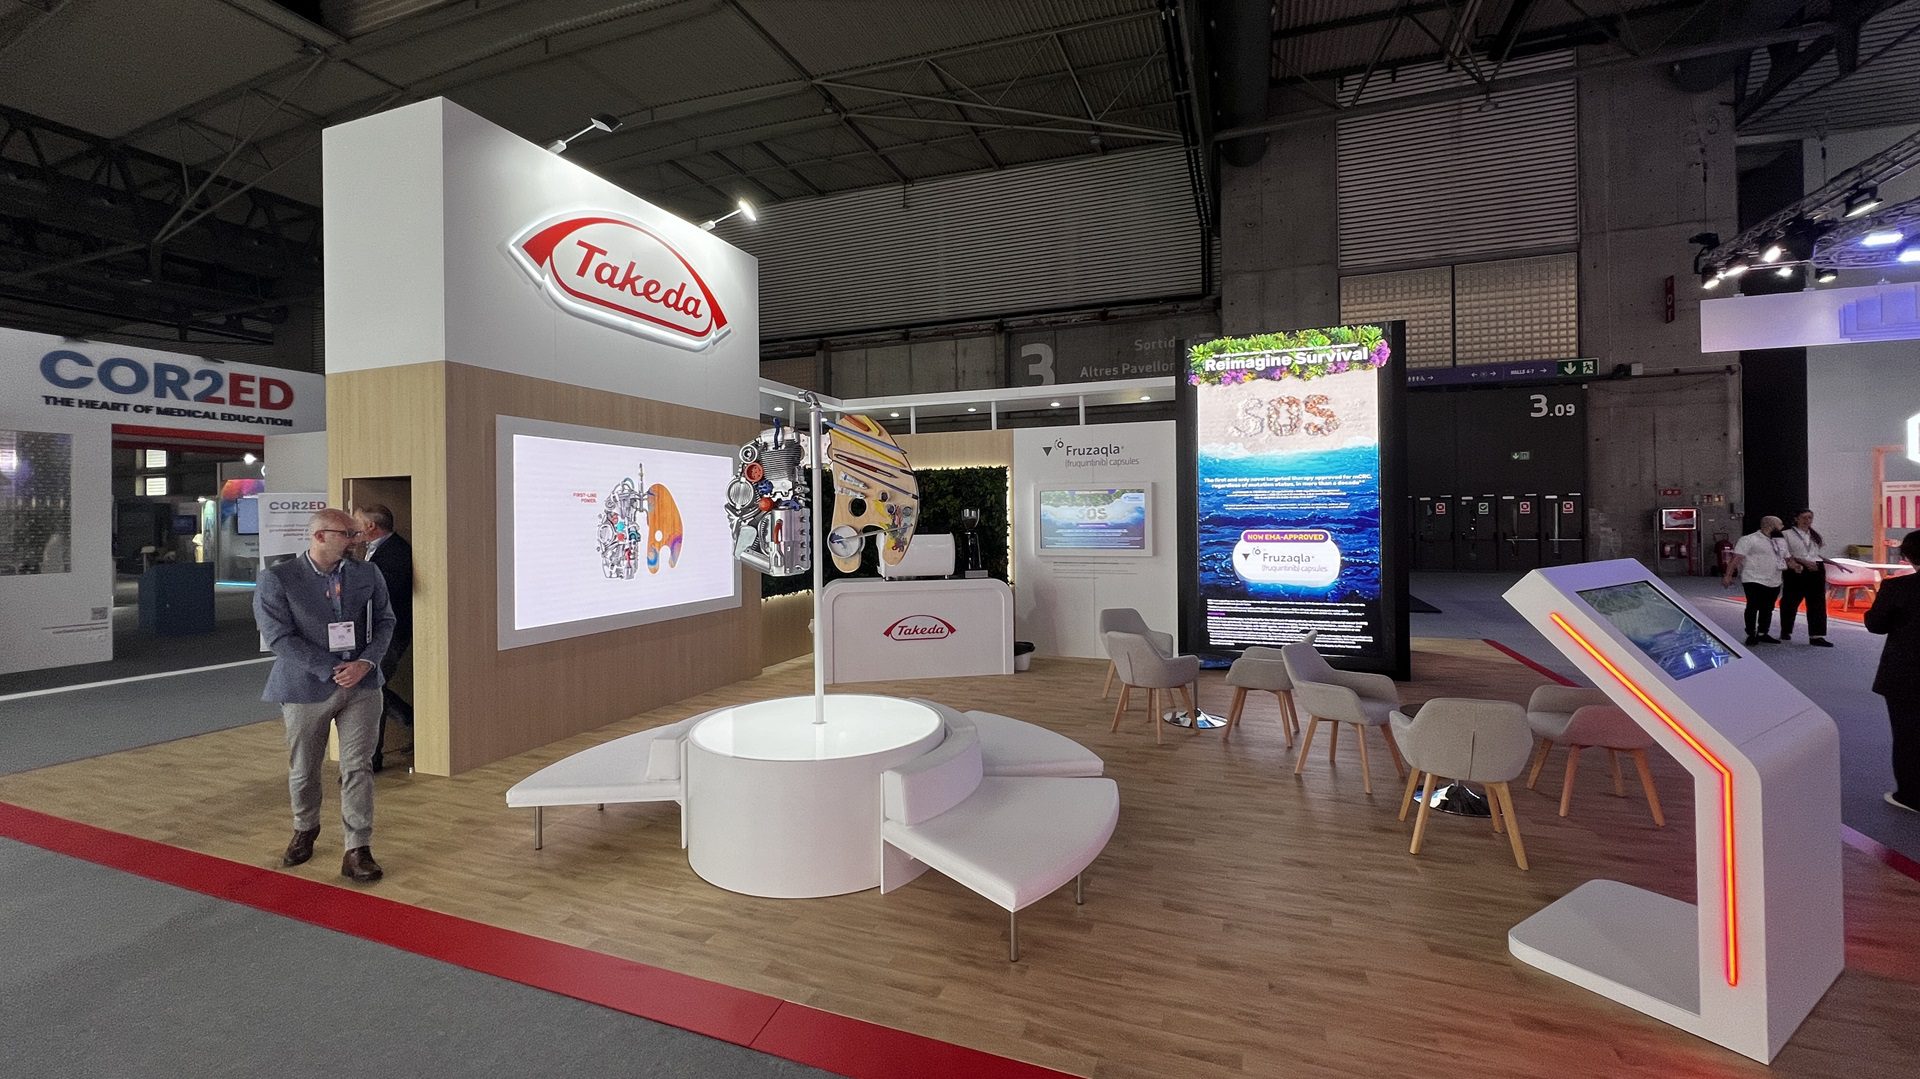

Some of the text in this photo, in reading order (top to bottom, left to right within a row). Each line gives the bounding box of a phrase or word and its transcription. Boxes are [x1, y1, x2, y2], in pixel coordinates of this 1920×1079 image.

[575, 239, 703, 319] Takeda
[1134, 336, 1175, 351] Sortid
[1021, 343, 1056, 385] 3
[1204, 354, 1292, 372] Reimagine
[1295, 346, 1369, 365] Survival
[39, 350, 295, 411] COR2ED
[1079, 365, 1119, 378] Altres
[42, 395, 293, 427] THE HEART OF MEDICAL EDUCATION
[1530, 394, 1576, 418] 3.09
[1230, 394, 1340, 438] SOS
[1109, 457, 1140, 467] capsules
[269, 501, 327, 510] COR2ED
[1076, 507, 1108, 520] SOS
[1300, 565, 1328, 574] capsules
[897, 624, 945, 636] Takeda
